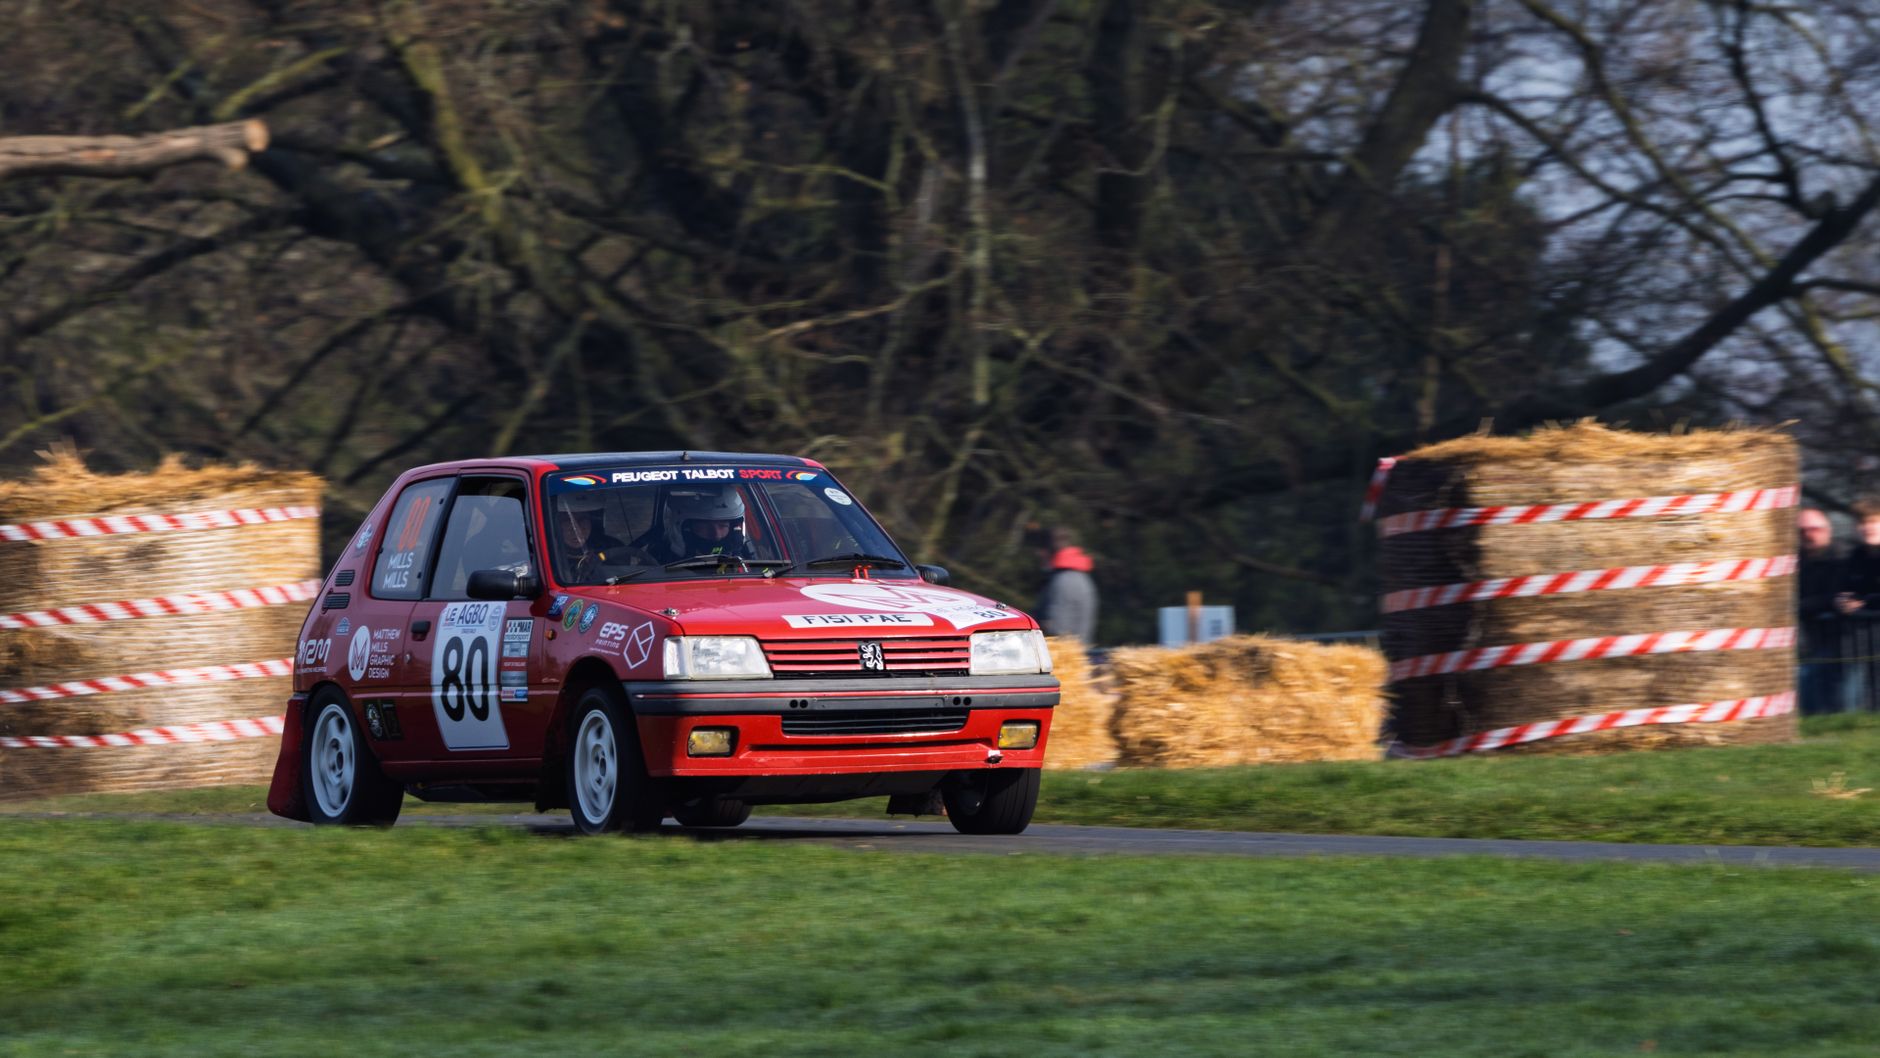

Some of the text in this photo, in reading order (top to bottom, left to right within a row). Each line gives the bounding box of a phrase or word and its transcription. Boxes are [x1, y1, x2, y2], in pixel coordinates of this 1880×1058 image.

[612, 469, 783, 483] PEUGEOT TALBOT SPORT
[387, 552, 414, 569] MILLS
[382, 570, 409, 589] MILLS
[445, 607, 458, 622] LE
[457, 604, 489, 625] AGBO
[802, 614, 913, 625] F151 PAE
[373, 628, 402, 639] MATTHEW
[599, 621, 629, 641] EPS
[370, 642, 389, 652] MILLS
[595, 638, 622, 649] PRINTING
[369, 655, 395, 666] GRAPHIC
[368, 667, 390, 679] DESIGN
[440, 635, 490, 722] 80
